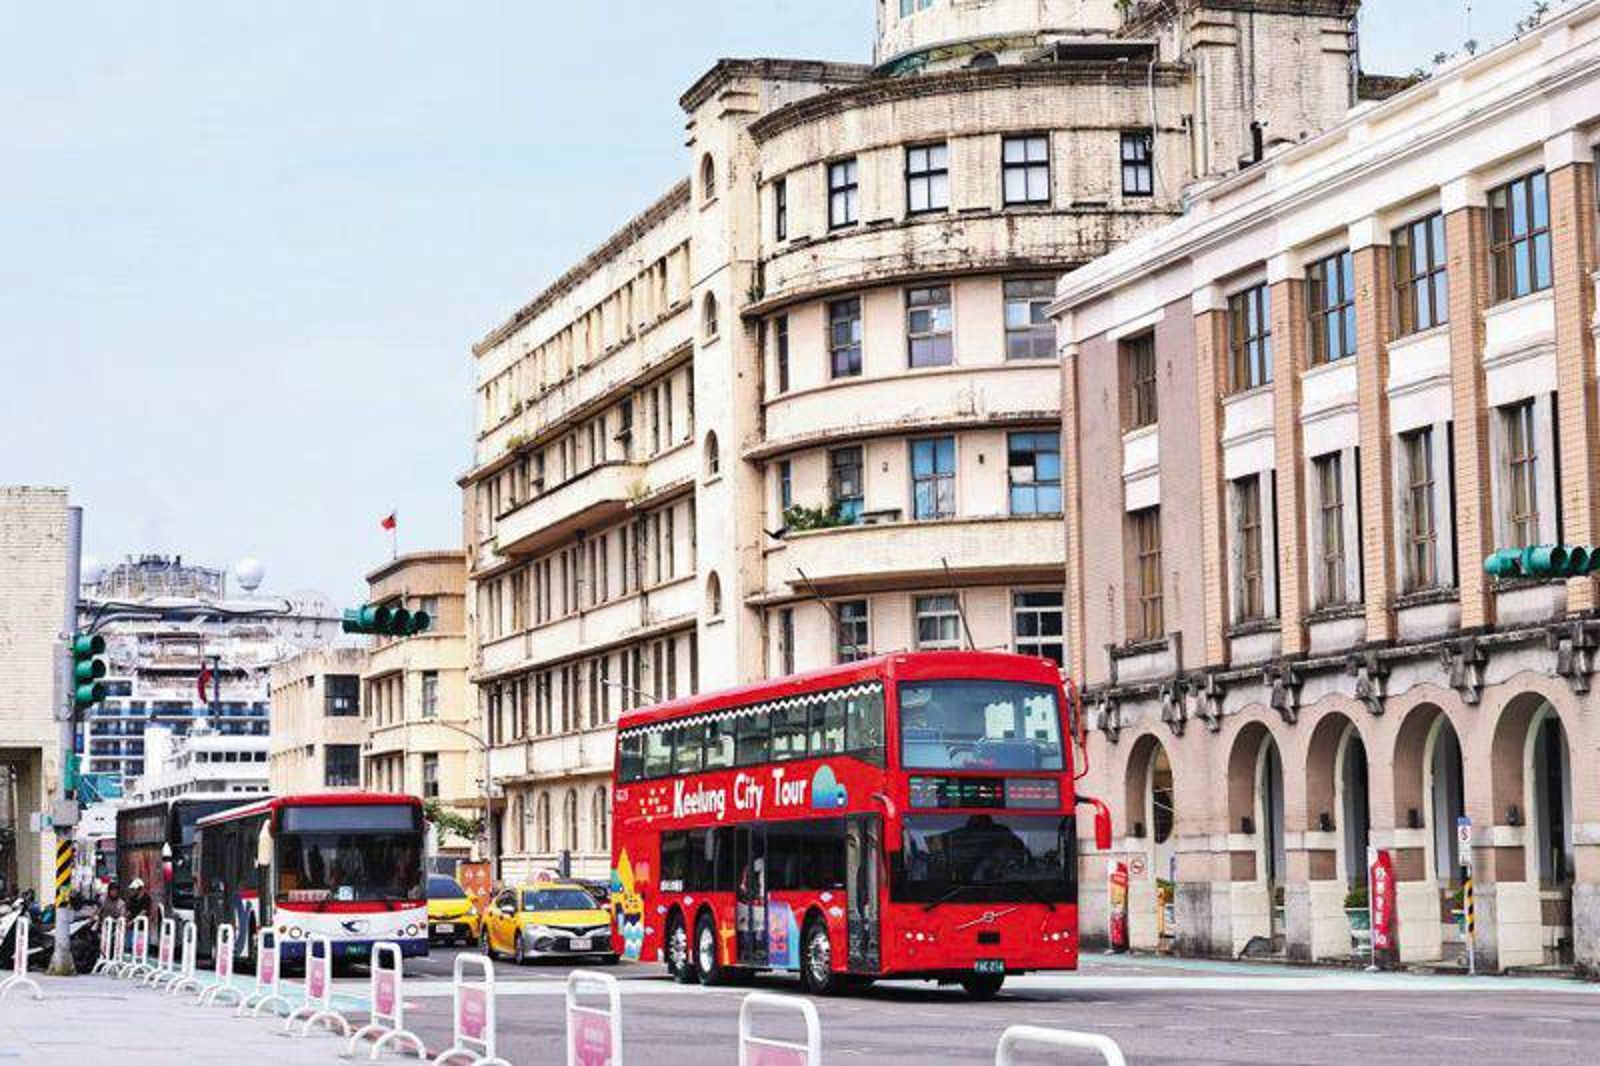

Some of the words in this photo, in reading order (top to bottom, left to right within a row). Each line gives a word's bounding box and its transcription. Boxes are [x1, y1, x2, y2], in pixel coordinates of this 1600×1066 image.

[673, 780, 726, 820] Keelung
[733, 773, 764, 817] City
[771, 767, 807, 806] Tour
